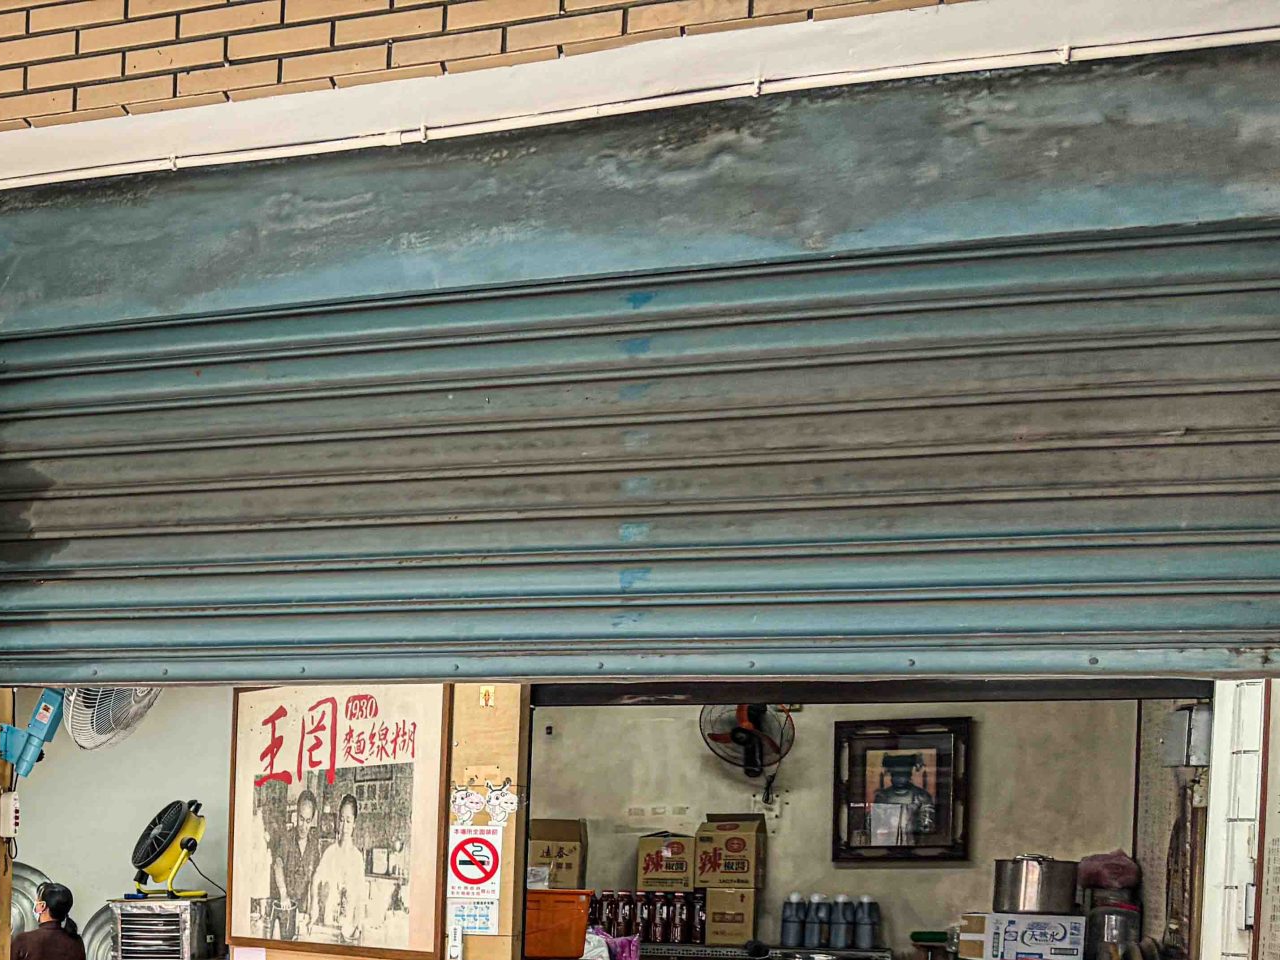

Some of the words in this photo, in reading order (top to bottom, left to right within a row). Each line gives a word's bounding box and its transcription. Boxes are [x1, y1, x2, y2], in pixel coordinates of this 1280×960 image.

[346, 697, 378, 720] 1930
[254, 697, 338, 787] 王罔
[342, 719, 417, 764] 麵線糊
